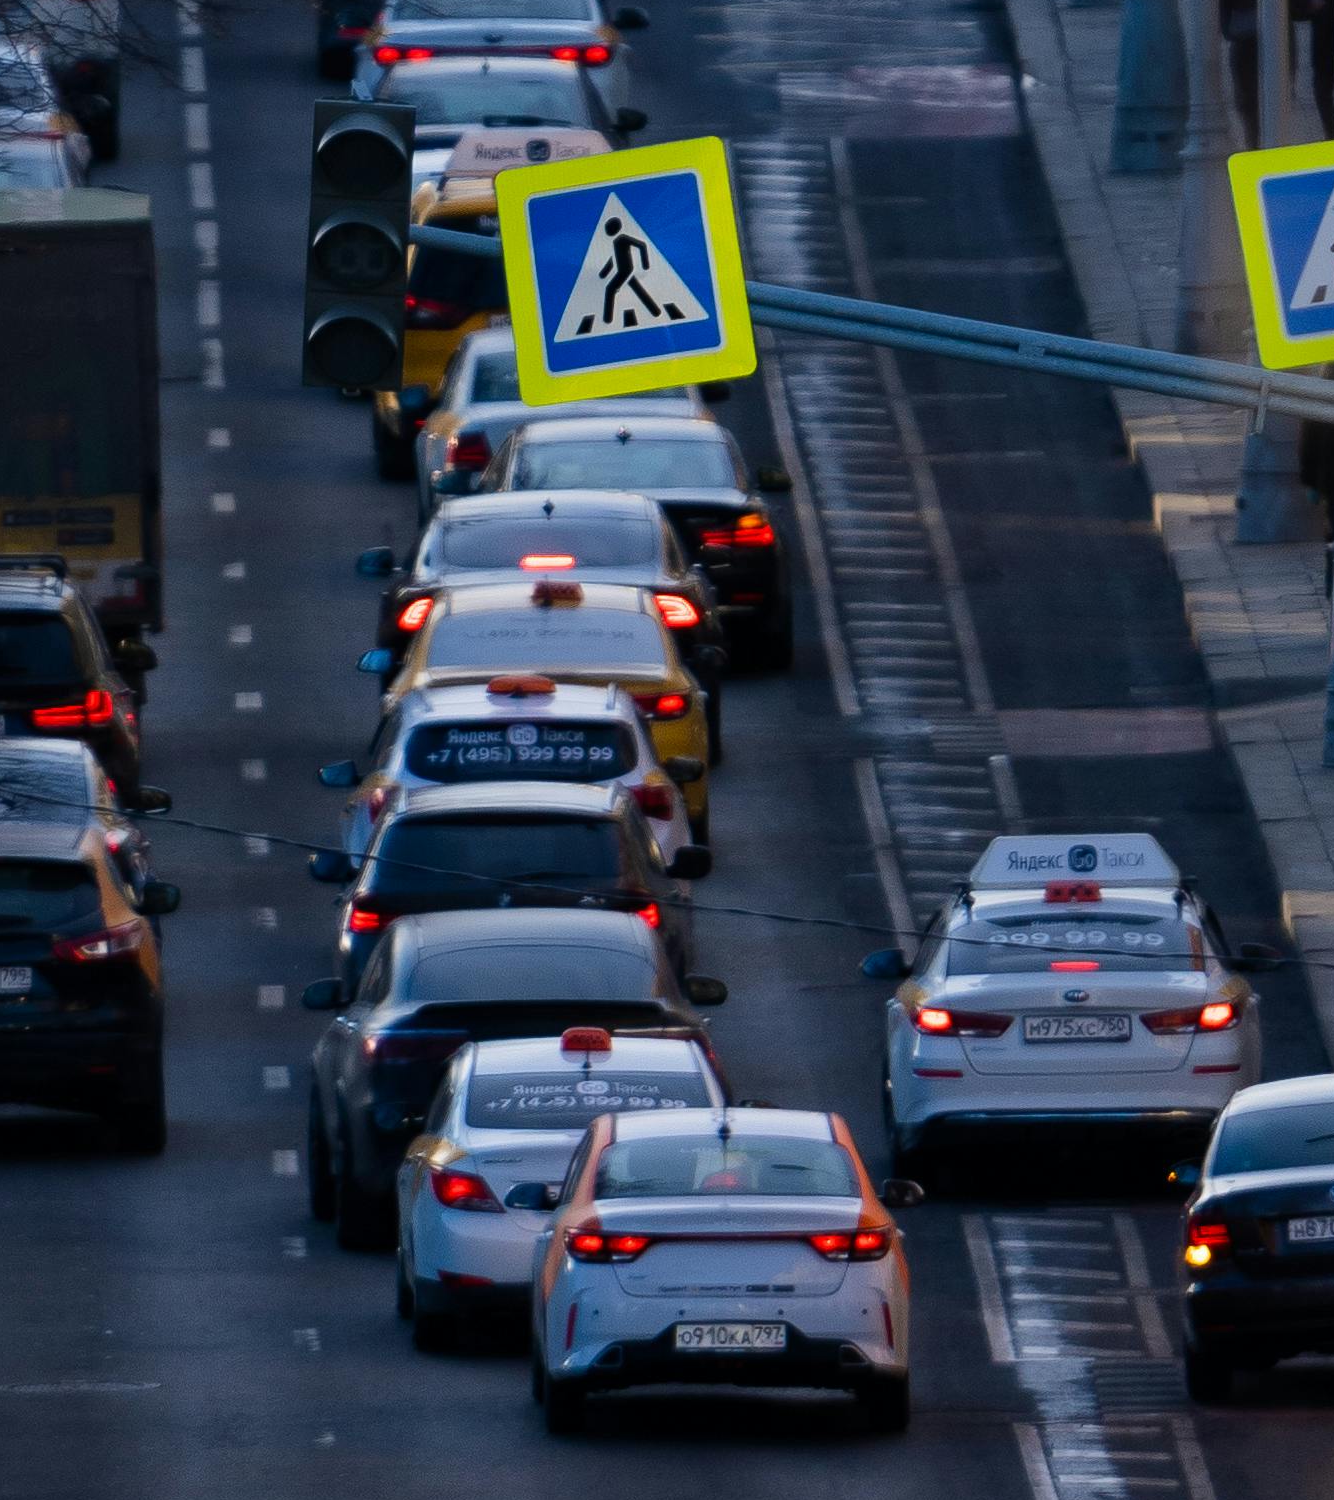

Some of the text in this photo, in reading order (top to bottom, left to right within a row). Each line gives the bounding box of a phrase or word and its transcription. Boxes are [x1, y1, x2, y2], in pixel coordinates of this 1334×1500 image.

[447, 729, 503, 745] Яндекс
[542, 726, 586, 742] Такси
[426, 746, 614, 764] +7 (495) 999 99 99
[1007, 850, 1065, 872] Яндекс
[1102, 847, 1145, 868] Такси
[513, 1083, 573, 1096] Яндекс
[613, 1081, 660, 1094] Такси
[485, 1098, 511, 1110] +7
[583, 1096, 623, 1107] 999
[628, 1096, 655, 1107] 99
[659, 1098, 687, 1109] 99
